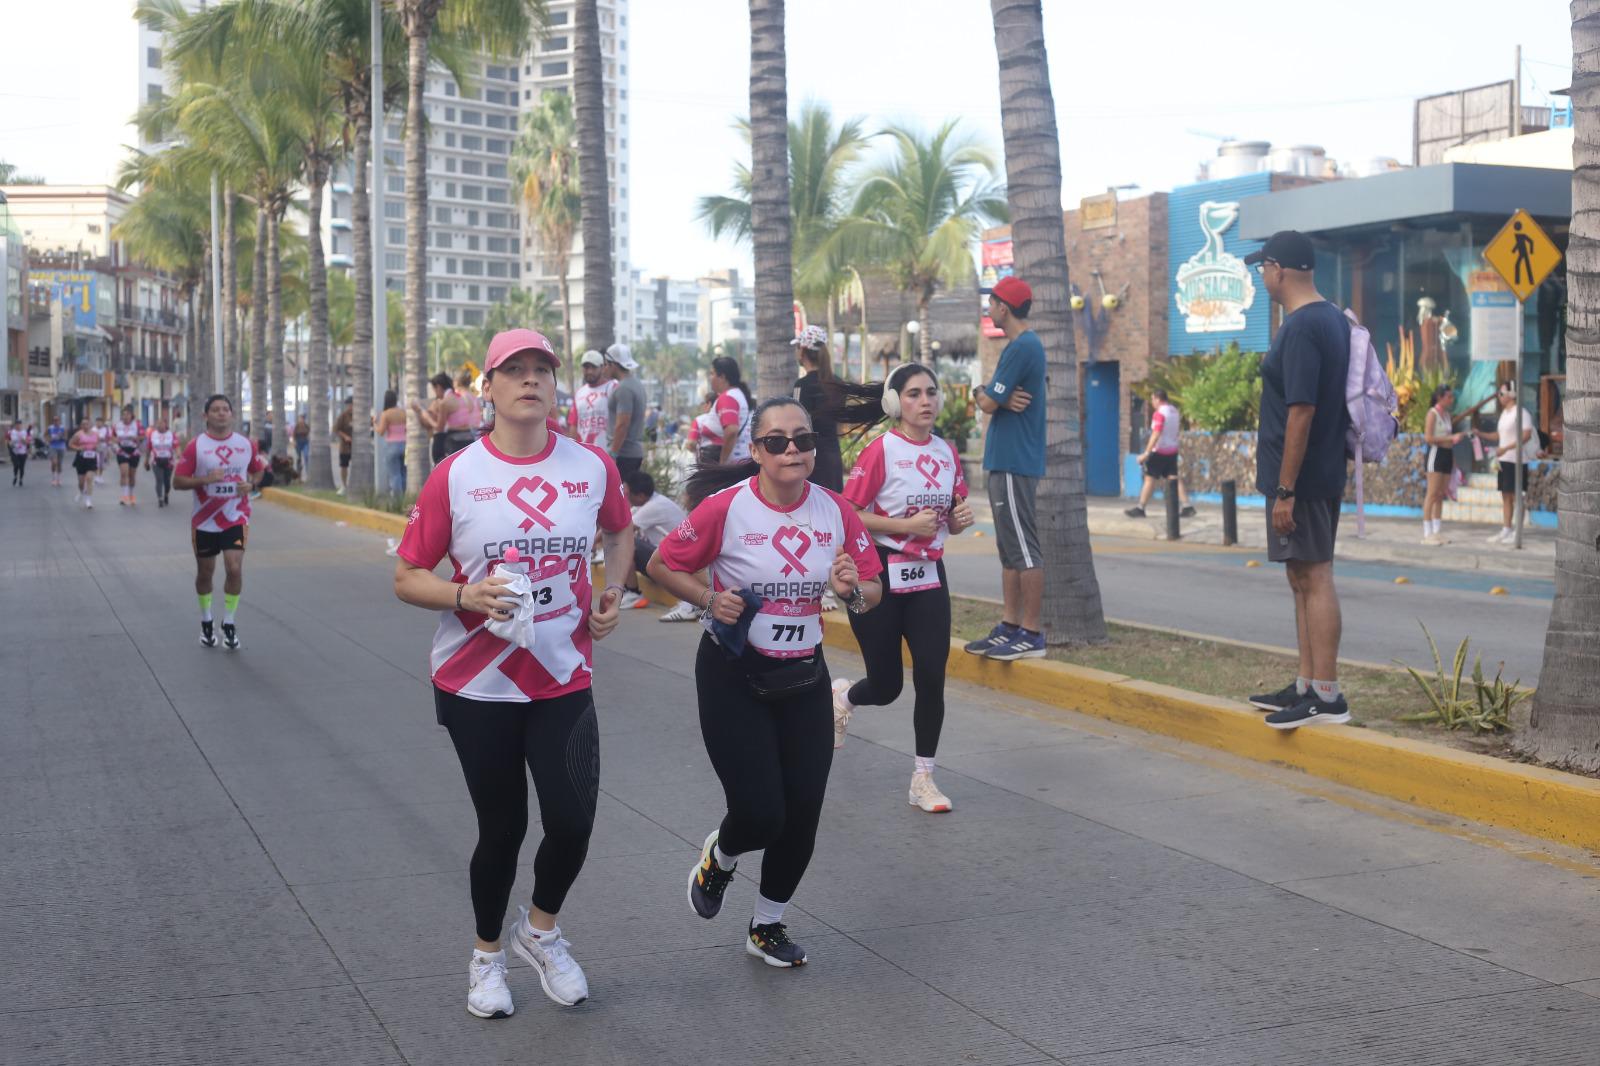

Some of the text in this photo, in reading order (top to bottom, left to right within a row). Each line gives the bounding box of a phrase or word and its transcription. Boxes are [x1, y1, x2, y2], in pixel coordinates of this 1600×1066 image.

[216, 486, 234, 494] 238
[567, 482, 589, 494] DIF
[817, 532, 832, 543] DIF
[483, 536, 588, 560] CARRERA
[901, 566, 925, 581] 566
[751, 581, 828, 597] CARRERA
[771, 623, 805, 642] 771
